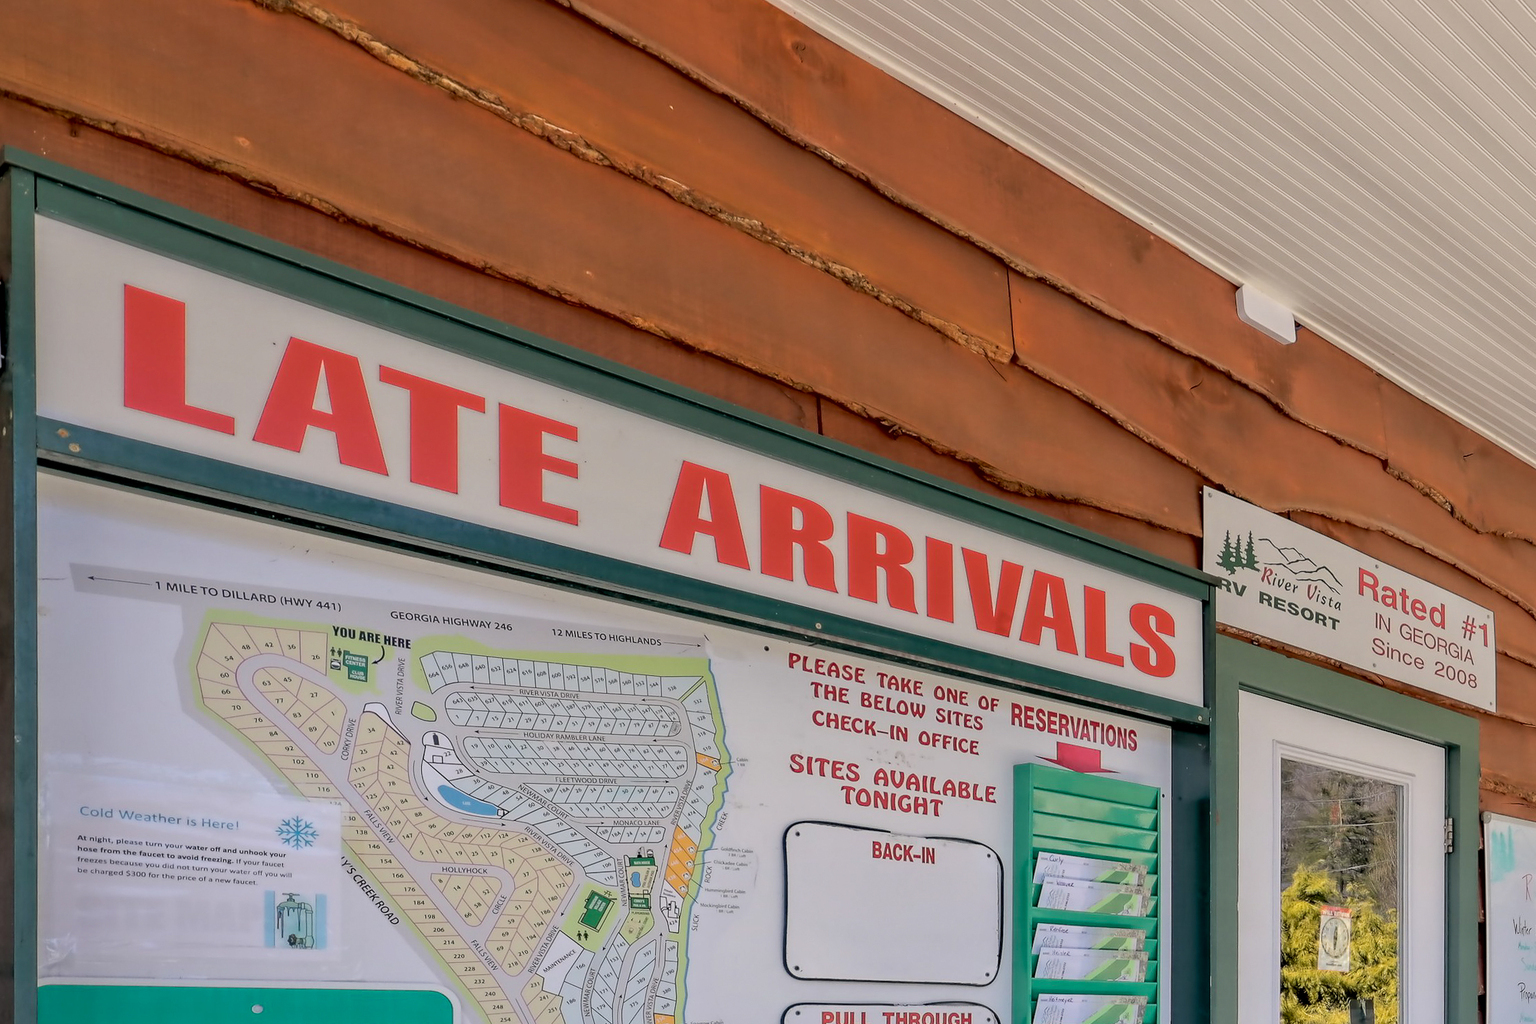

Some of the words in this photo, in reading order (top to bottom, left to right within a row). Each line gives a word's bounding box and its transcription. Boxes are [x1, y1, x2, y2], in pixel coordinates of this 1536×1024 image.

[124, 284, 578, 526] LATE
[659, 460, 1176, 678] ARRIVALS
[155, 581, 161, 590] 1
[166, 582, 198, 594] MILE
[200, 586, 218, 597] TO
[222, 589, 277, 604] DILLARD
[280, 596, 312, 608] (HWY
[316, 600, 342, 612] 441)
[1219, 577, 1247, 597] RV
[1259, 591, 1340, 631] RESORT
[1261, 567, 1298, 594] River
[1307, 584, 1342, 611] Vista
[390, 611, 440, 625] GEORGIA
[442, 615, 491, 630] HIGHWAY
[494, 621, 513, 631] 246
[1359, 567, 1446, 630] Rated
[1462, 615, 1489, 648] #1
[332, 625, 356, 639] YOU
[359, 631, 381, 644] ARE
[383, 635, 411, 649] HERE
[551, 628, 563, 637] 12
[565, 629, 592, 641] MILES
[594, 632, 607, 641] TO
[609, 633, 662, 647] HIGHLANDS
[1375, 613, 1391, 633] IN
[1400, 624, 1475, 665] GEORGIA
[1372, 637, 1424, 670] Since
[1434, 661, 1478, 689] 2008
[788, 652, 866, 684] PLEASE
[876, 672, 923, 695] TAKE
[933, 685, 969, 706] ONE
[978, 695, 999, 713] OF
[810, 682, 849, 704] THE
[861, 692, 925, 719] BELOW
[935, 708, 984, 731] SITES
[812, 709, 908, 742] CHECK-IN
[918, 730, 980, 755] OFFICE
[1011, 703, 1138, 752] RESERVATIONS
[790, 753, 860, 782] SITES
[873, 768, 997, 803] AVAILABLE
[841, 785, 943, 817] TONIGHT
[80, 806, 113, 818] Cold
[118, 809, 181, 824] Weather
[186, 817, 197, 827] is
[202, 818, 239, 830] Here!
[363, 809, 382, 829] FALLS
[378, 826, 394, 844] VIEW
[89, 836, 113, 844] night,
[872, 841, 935, 865] BACK-IN
[77, 856, 107, 864] freezes
[109, 858, 143, 867] because
[90, 868, 124, 876] charged
[126, 870, 146, 878] $300
[139, 850, 165, 858] faucet
[201, 855, 234, 864] freezing.
[262, 860, 284, 868] faucet
[442, 866, 488, 874] HOLLYHOCK
[352, 874, 381, 902] CREEK
[375, 898, 400, 925] ROAD
[470, 939, 488, 960] FALLS
[483, 955, 498, 971] VIEW
[543, 949, 577, 973] MAINTENANCE
